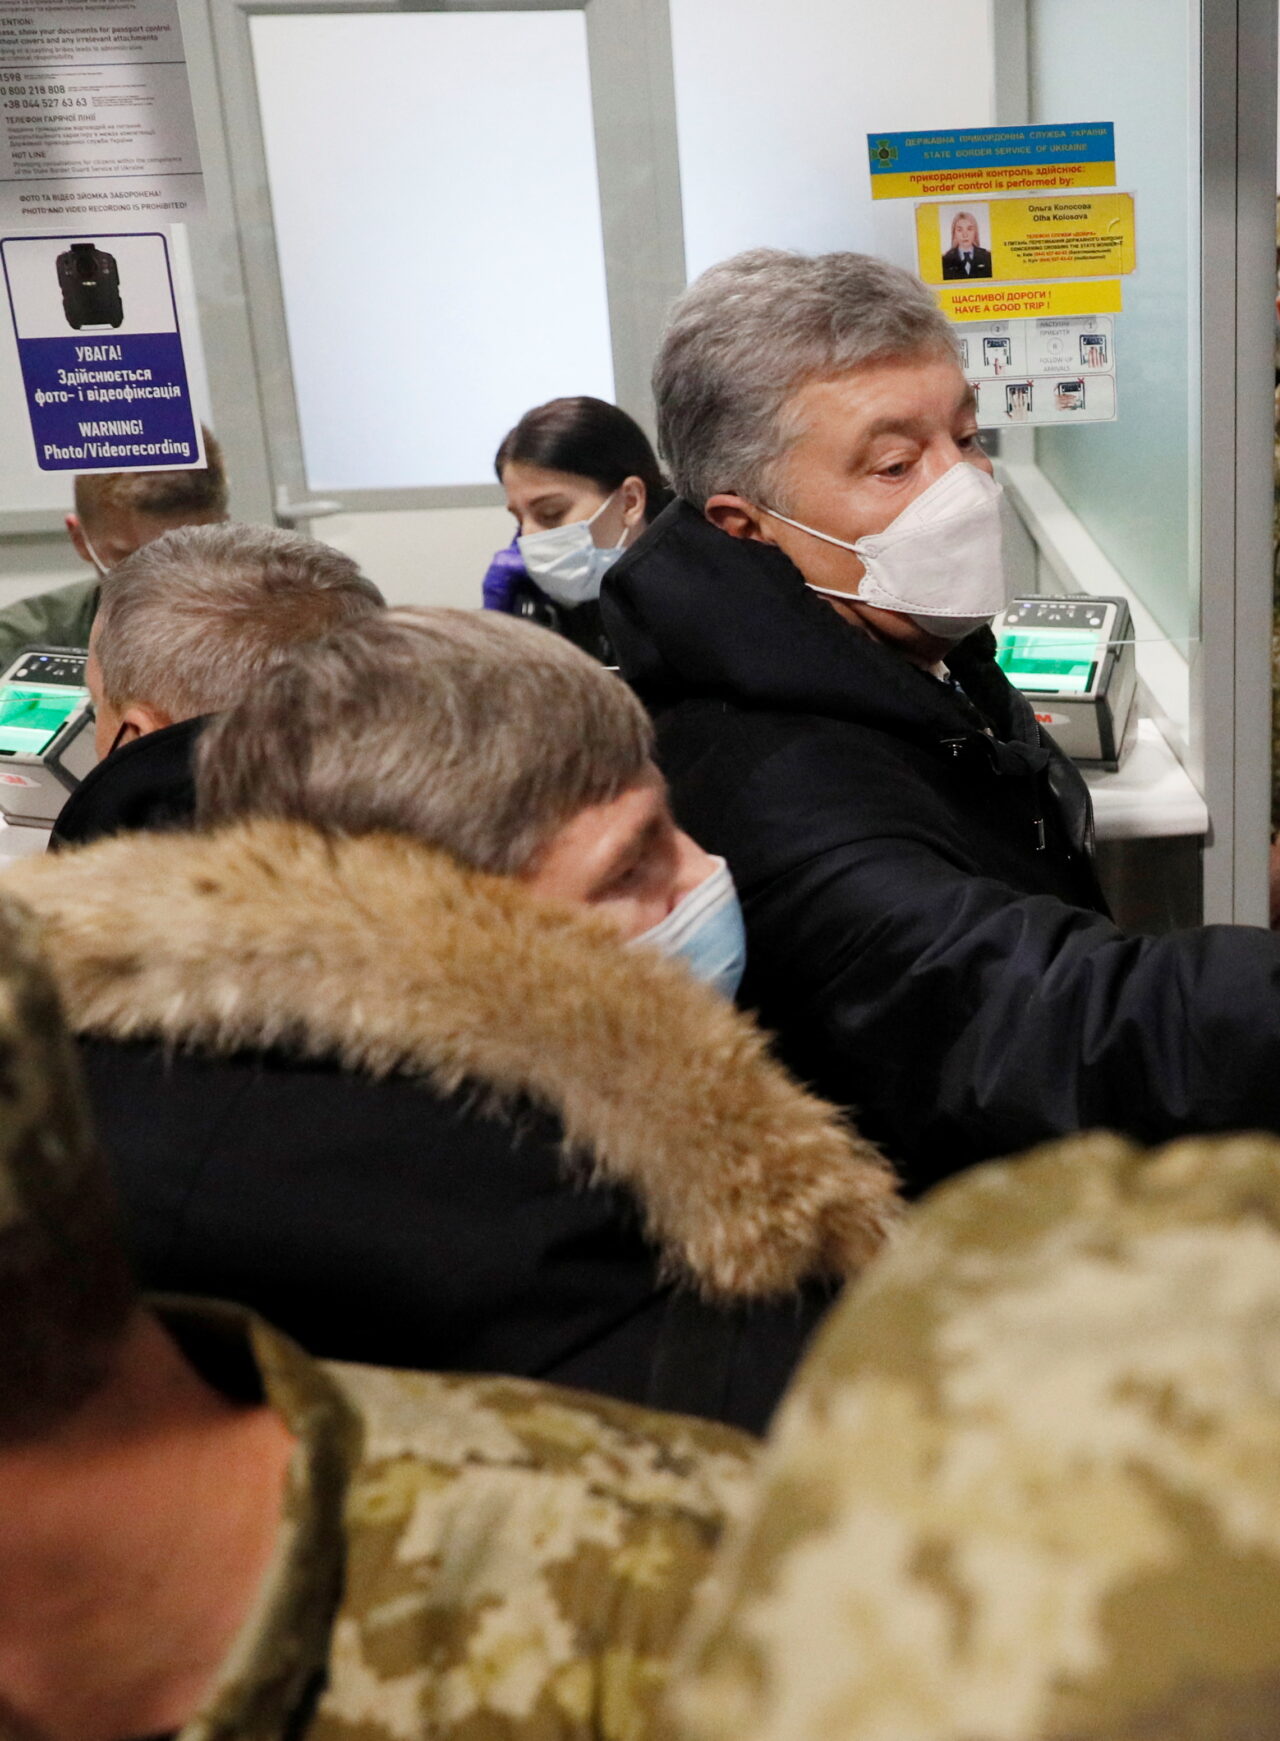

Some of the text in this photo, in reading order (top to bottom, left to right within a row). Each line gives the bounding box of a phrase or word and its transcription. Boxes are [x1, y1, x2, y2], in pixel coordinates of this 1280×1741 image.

[0, 17, 33, 26] ENTION!
[8, 86, 26, 95] 800
[28, 85, 46, 95] 218
[47, 84, 66, 94] 808
[22, 99, 40, 109] 044
[41, 98, 60, 108] 527
[61, 98, 74, 107] 63
[75, 97, 88, 107] 63
[924, 150, 951, 159] STATE
[956, 147, 993, 158] BORDER
[995, 145, 1032, 155] SERVICE
[1036, 144, 1047, 153] OF
[909, 169, 983, 184] прикордонний
[986, 166, 1034, 179] контроль
[922, 175, 1075, 193] border control is performed by:
[1028, 201, 1092, 214] Ольга Колосова
[1032, 211, 1089, 223] Olha Kolosova
[951, 289, 1005, 305] ЩАСЛИВОЇ
[1007, 290, 1047, 302] ДОРОГИ
[955, 303, 981, 315] HAVE
[983, 303, 990, 313] A
[992, 302, 1022, 313] GOOD
[1024, 300, 1045, 311] TRIP
[75, 345, 122, 362] УВАГА!
[57, 368, 152, 387] Здійснюється
[78, 387, 84, 402] і
[87, 382, 182, 403] відеофіксація
[78, 419, 144, 438] WARNING!
[43, 438, 191, 461] Photo/Videorecording
